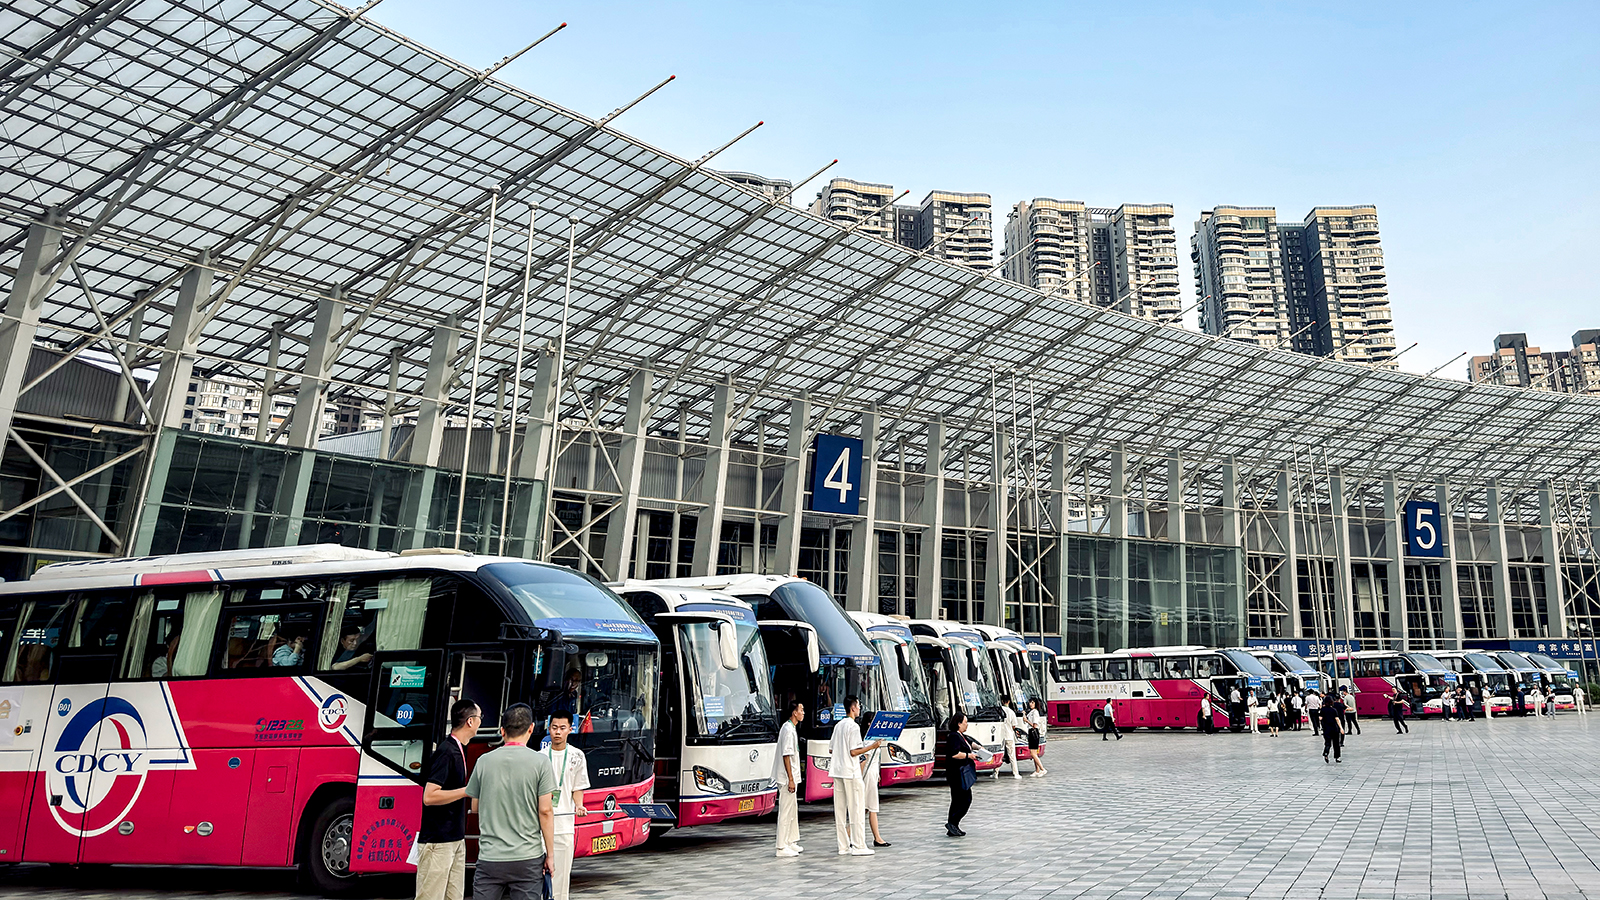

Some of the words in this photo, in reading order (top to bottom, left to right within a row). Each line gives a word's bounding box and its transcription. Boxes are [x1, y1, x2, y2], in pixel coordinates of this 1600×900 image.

[823, 447, 853, 504] 4
[1415, 508, 1437, 550] 5
[57, 702, 71, 712] B01
[396, 710, 413, 720] B01
[55, 752, 143, 774] CDCY
[597, 766, 625, 777] FOTON
[740, 782, 760, 793] HIGER
